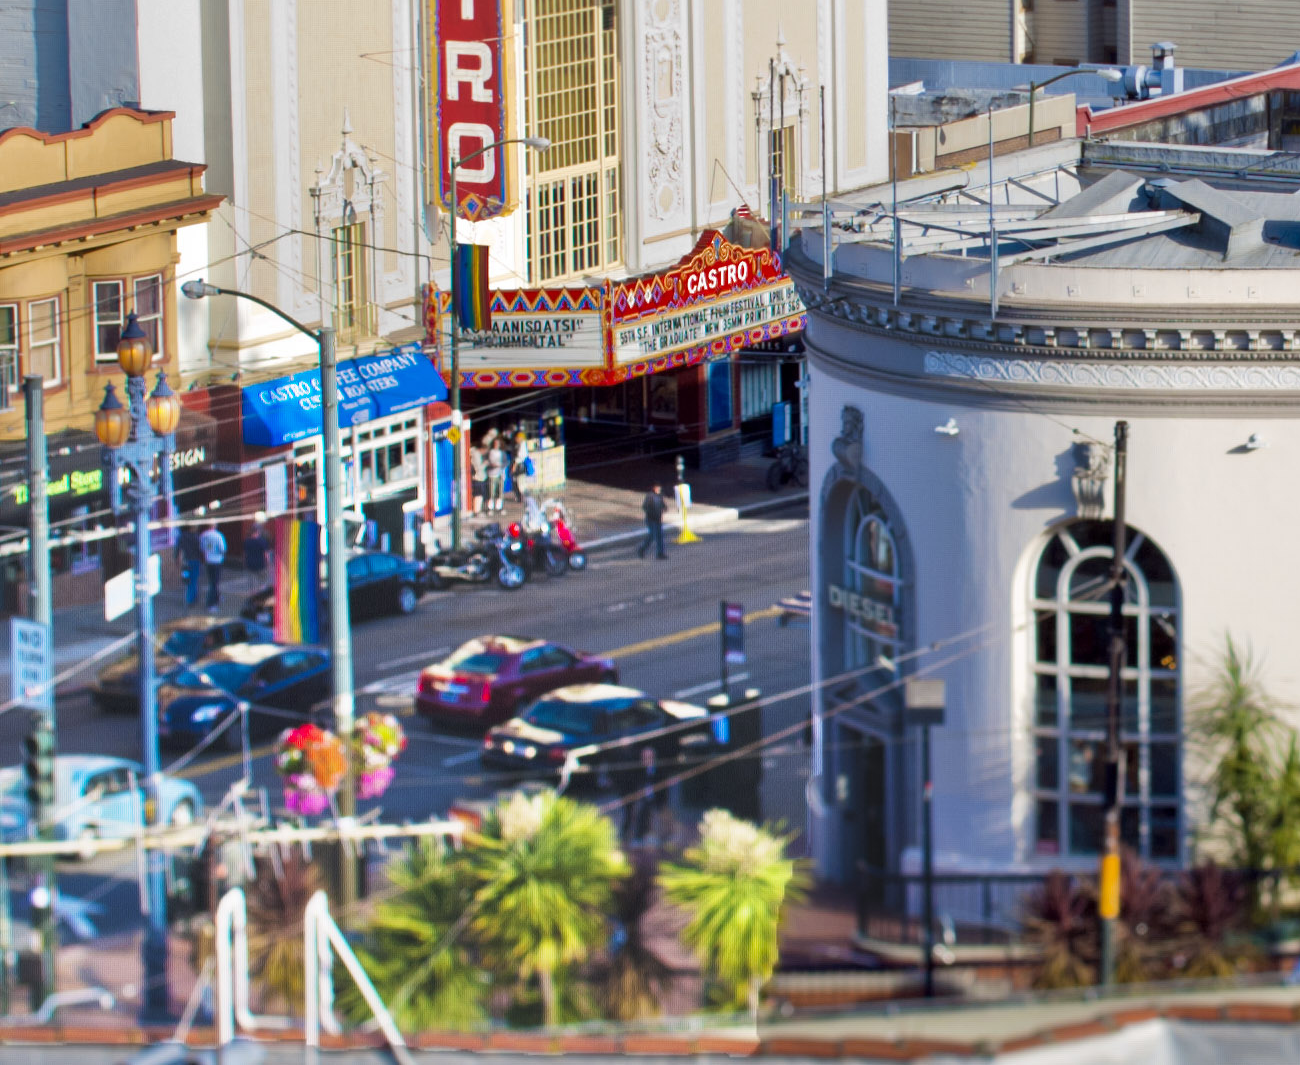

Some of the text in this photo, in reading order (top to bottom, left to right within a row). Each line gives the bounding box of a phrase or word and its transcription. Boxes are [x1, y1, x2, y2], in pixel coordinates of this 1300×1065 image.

[687, 261, 748, 294] CASTRO
[651, 308, 707, 336] INTERNATIONAL
[730, 296, 764, 317] FESTIVAL
[704, 320, 719, 336] NEW
[723, 314, 742, 331] 35MM
[770, 302, 785, 317] MAY
[259, 352, 418, 405] CASTRO CFEE COMPANY
[344, 374, 399, 400] ROASTERS
[828, 584, 895, 625] DIESEL
